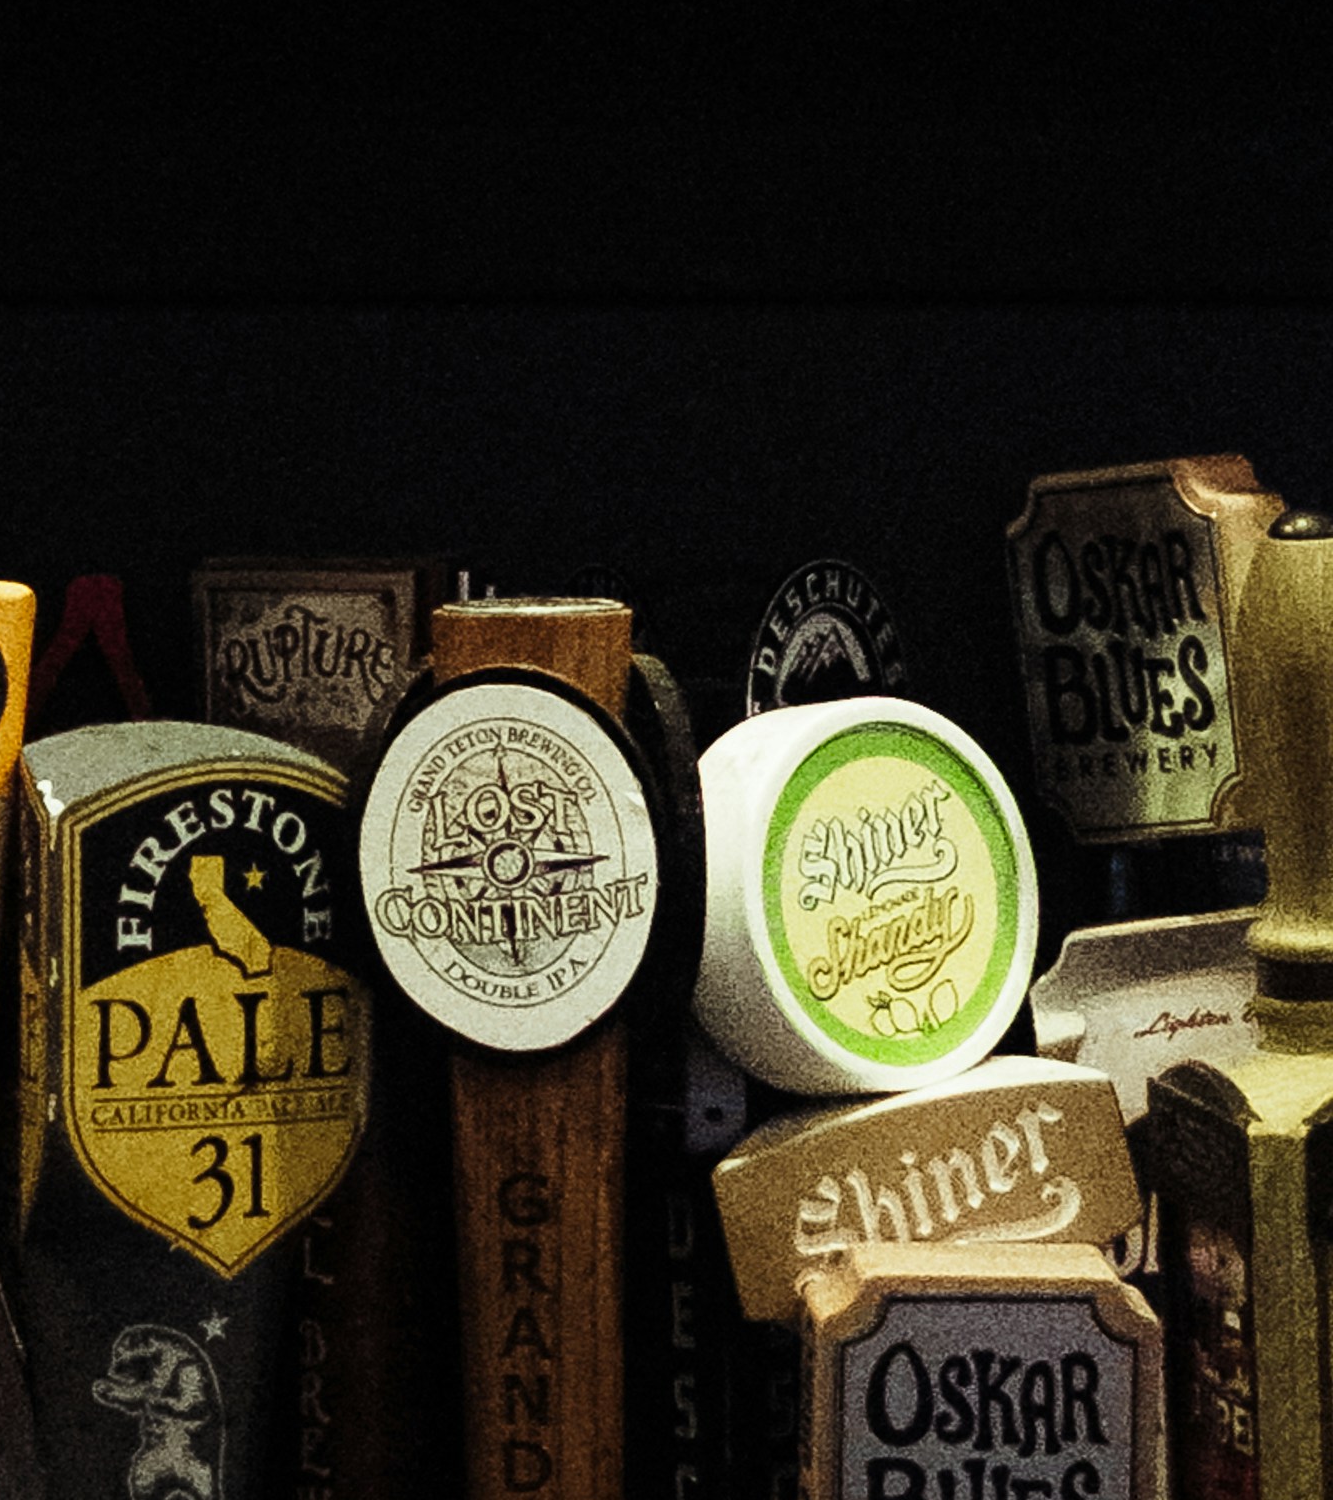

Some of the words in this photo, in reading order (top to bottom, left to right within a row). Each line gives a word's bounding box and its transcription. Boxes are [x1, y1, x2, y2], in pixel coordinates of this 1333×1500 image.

[757, 570, 904, 690] DESCHUTES
[1033, 530, 1205, 642] OSKAR
[223, 605, 397, 703] RUPTURE
[1041, 634, 1217, 746] BLUES
[406, 755, 447, 814] GRAND
[442, 726, 502, 759] TETON
[507, 726, 581, 777] BREWING
[432, 780, 579, 852] LOST
[1048, 740, 1219, 784] BREWERY
[115, 786, 333, 952] FIRESTONE
[797, 778, 955, 912] Shiner
[374, 874, 649, 946] CONTINENT
[806, 890, 975, 1002] Shandy
[443, 961, 540, 999] DOUBLE
[546, 958, 589, 992] IPA
[90, 986, 352, 1090] PALE
[91, 1101, 247, 1126] CALIFORNIA
[188, 1134, 271, 1232] 31
[793, 1098, 1081, 1256] Shiner
[498, 1170, 556, 1493] GRAND
[866, 1341, 1109, 1457] OSKAR
